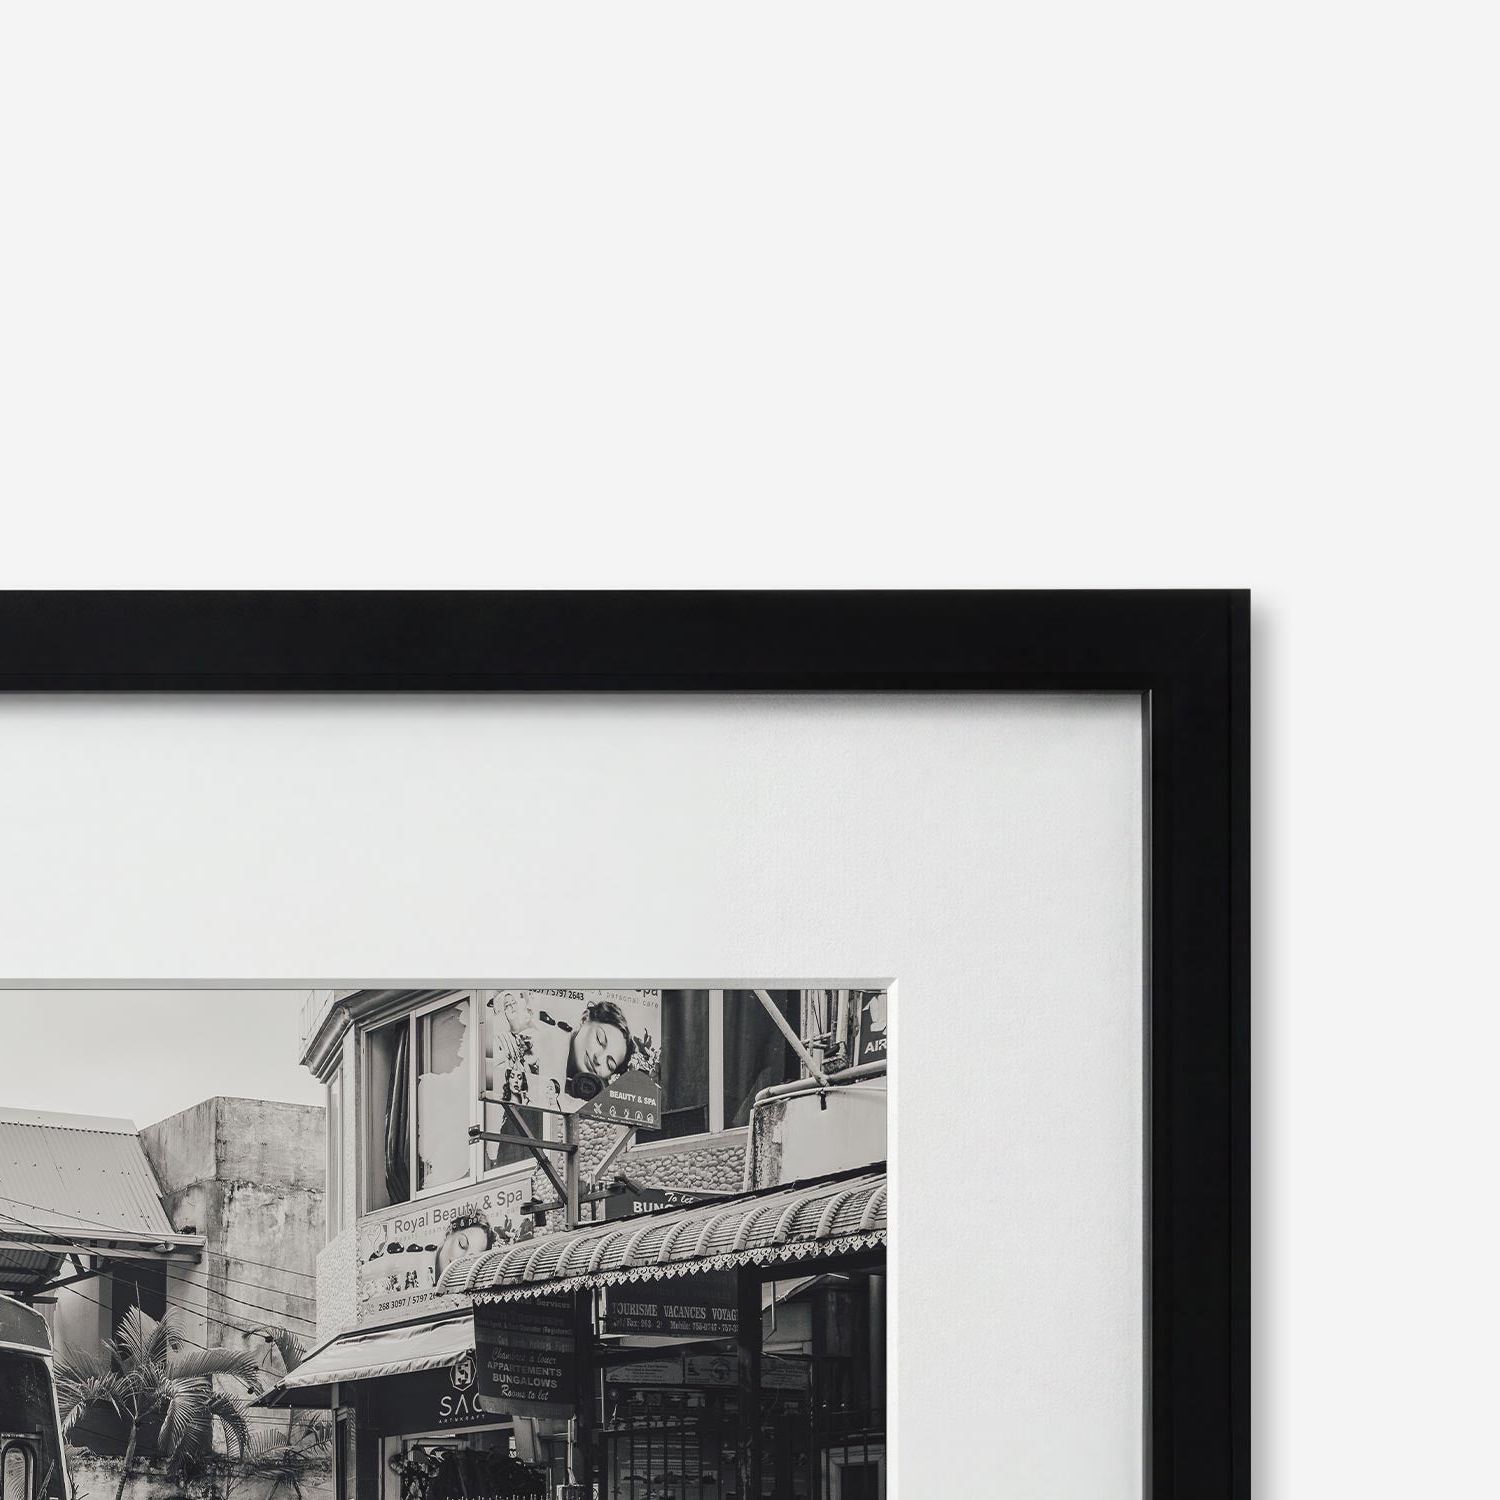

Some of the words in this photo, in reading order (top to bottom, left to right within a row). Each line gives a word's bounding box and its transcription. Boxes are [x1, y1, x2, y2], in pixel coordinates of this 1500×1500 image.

[568, 990, 584, 1000] 2643
[635, 989, 658, 998] pa
[609, 1090, 636, 1102] BEAUTY
[637, 1096, 642, 1104] &
[643, 1097, 657, 1106] SPA
[664, 1192, 677, 1203] To
[680, 1195, 694, 1204] let
[394, 1212, 429, 1234] Royal
[433, 1201, 478, 1224] Beauty
[482, 1195, 492, 1210] &
[496, 1189, 523, 1208] Spa
[633, 1201, 674, 1213] BUN
[378, 1302, 390, 1312] 268
[391, 1299, 406, 1309] 3097
[412, 1294, 428, 1304] 5797
[536, 1298, 571, 1309] Services
[612, 1302, 658, 1317] TOURISME
[663, 1305, 706, 1320] VACANCES
[711, 1308, 739, 1321] VOYAG
[487, 1361, 563, 1377] APPARTEMENTS
[492, 1373, 558, 1388] BUNGALOWS
